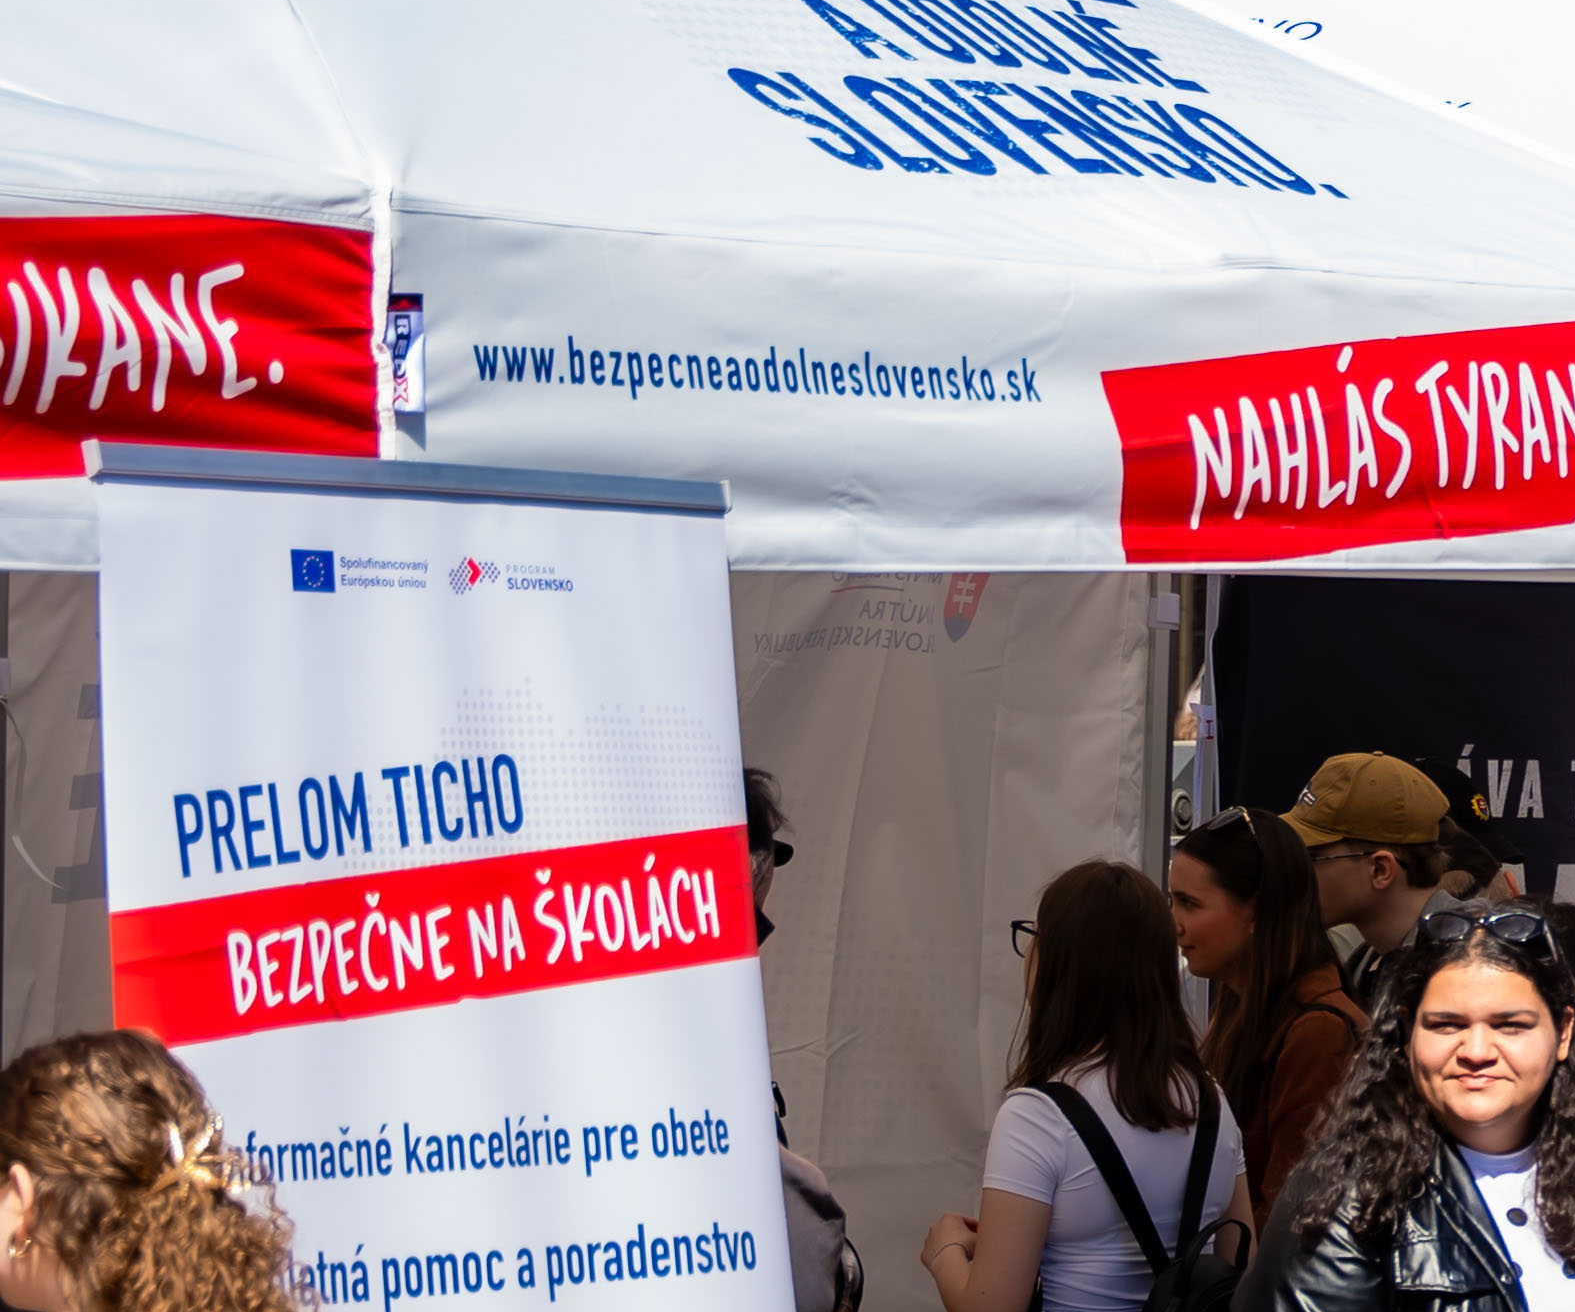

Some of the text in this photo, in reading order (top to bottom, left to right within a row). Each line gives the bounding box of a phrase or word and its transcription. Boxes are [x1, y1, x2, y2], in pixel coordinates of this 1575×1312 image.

[728, 67, 1351, 199] SLOVENSKO.
[0, 261, 284, 416] IKANE.
[473, 335, 1042, 403] www.bezpecneaodolneslovensko.sk
[1188, 344, 1413, 531] NAHLÁS
[340, 556, 429, 574] Spolufinancovaný
[340, 573, 427, 590] Európskou úniou
[507, 576, 574, 592] SLOVENSKO
[173, 753, 524, 879] PRELOM TICHO
[226, 852, 720, 1015] BEZPEČNE NA ŠKOLÁCH
[227, 1107, 730, 1185] nformačné kancelárie pre obete
[516, 1247, 536, 1289] a
[546, 1220, 757, 1303] poradenstvo
